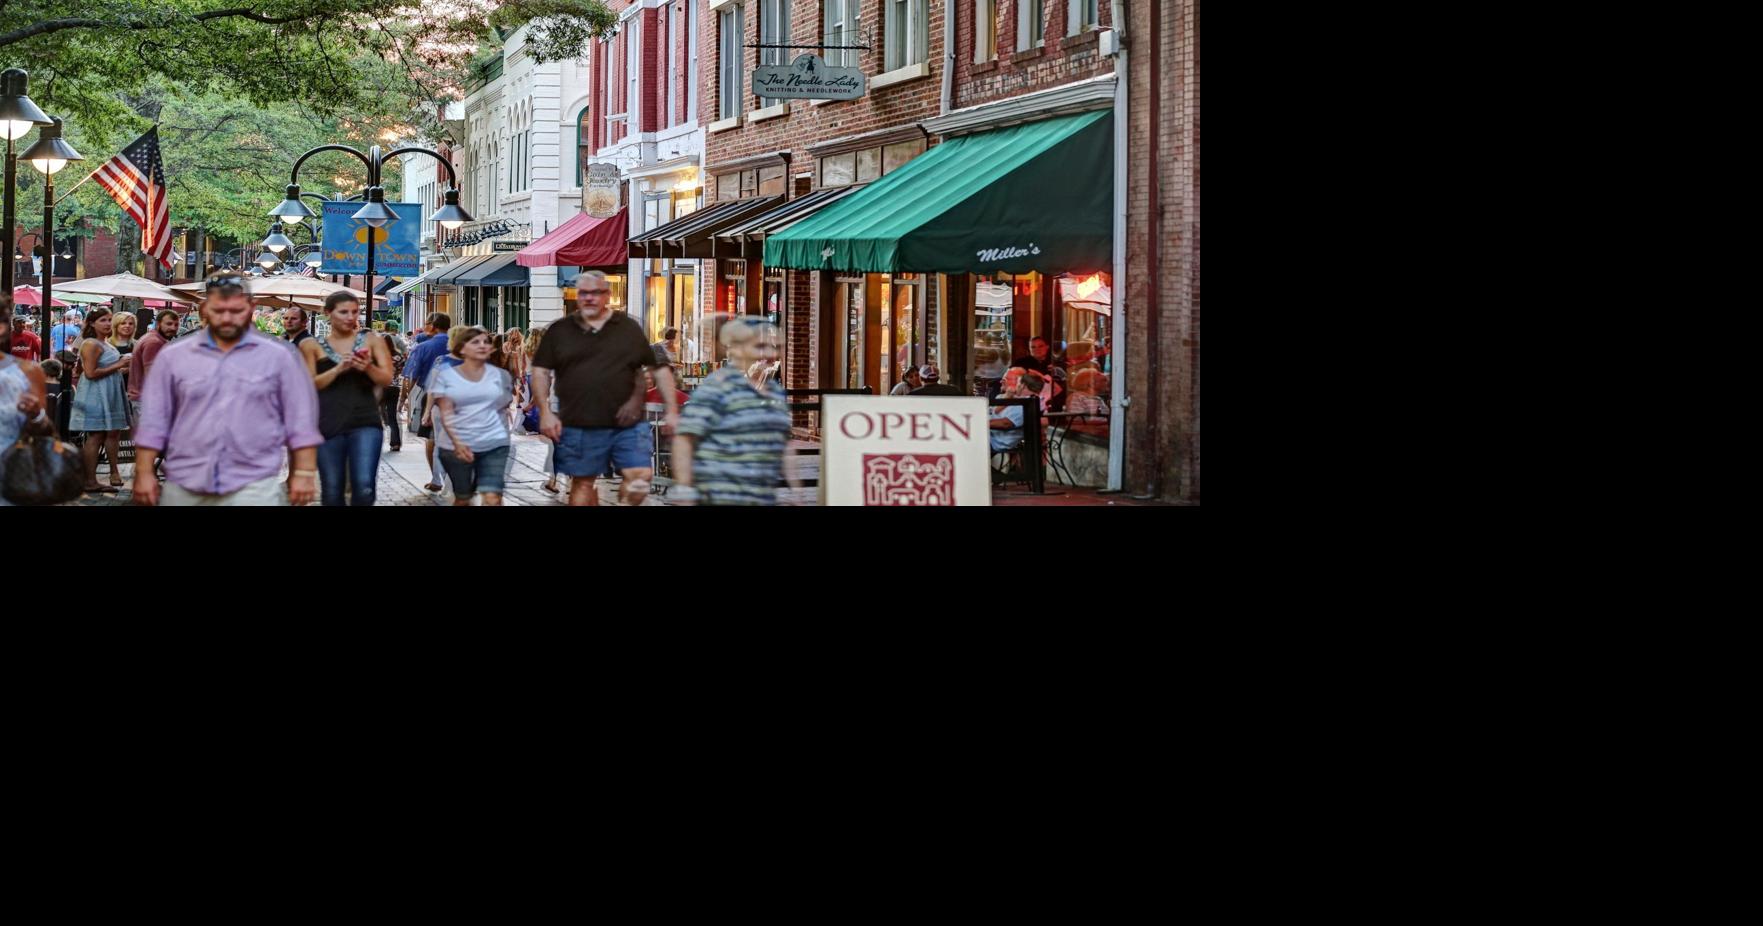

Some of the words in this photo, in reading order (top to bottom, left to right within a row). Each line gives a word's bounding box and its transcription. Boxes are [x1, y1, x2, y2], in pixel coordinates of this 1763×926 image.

[757, 73, 785, 86] The
[786, 73, 823, 87] Needle
[825, 75, 860, 90] Lady
[976, 242, 1041, 262] Miller's
[839, 411, 973, 441] OPEN
